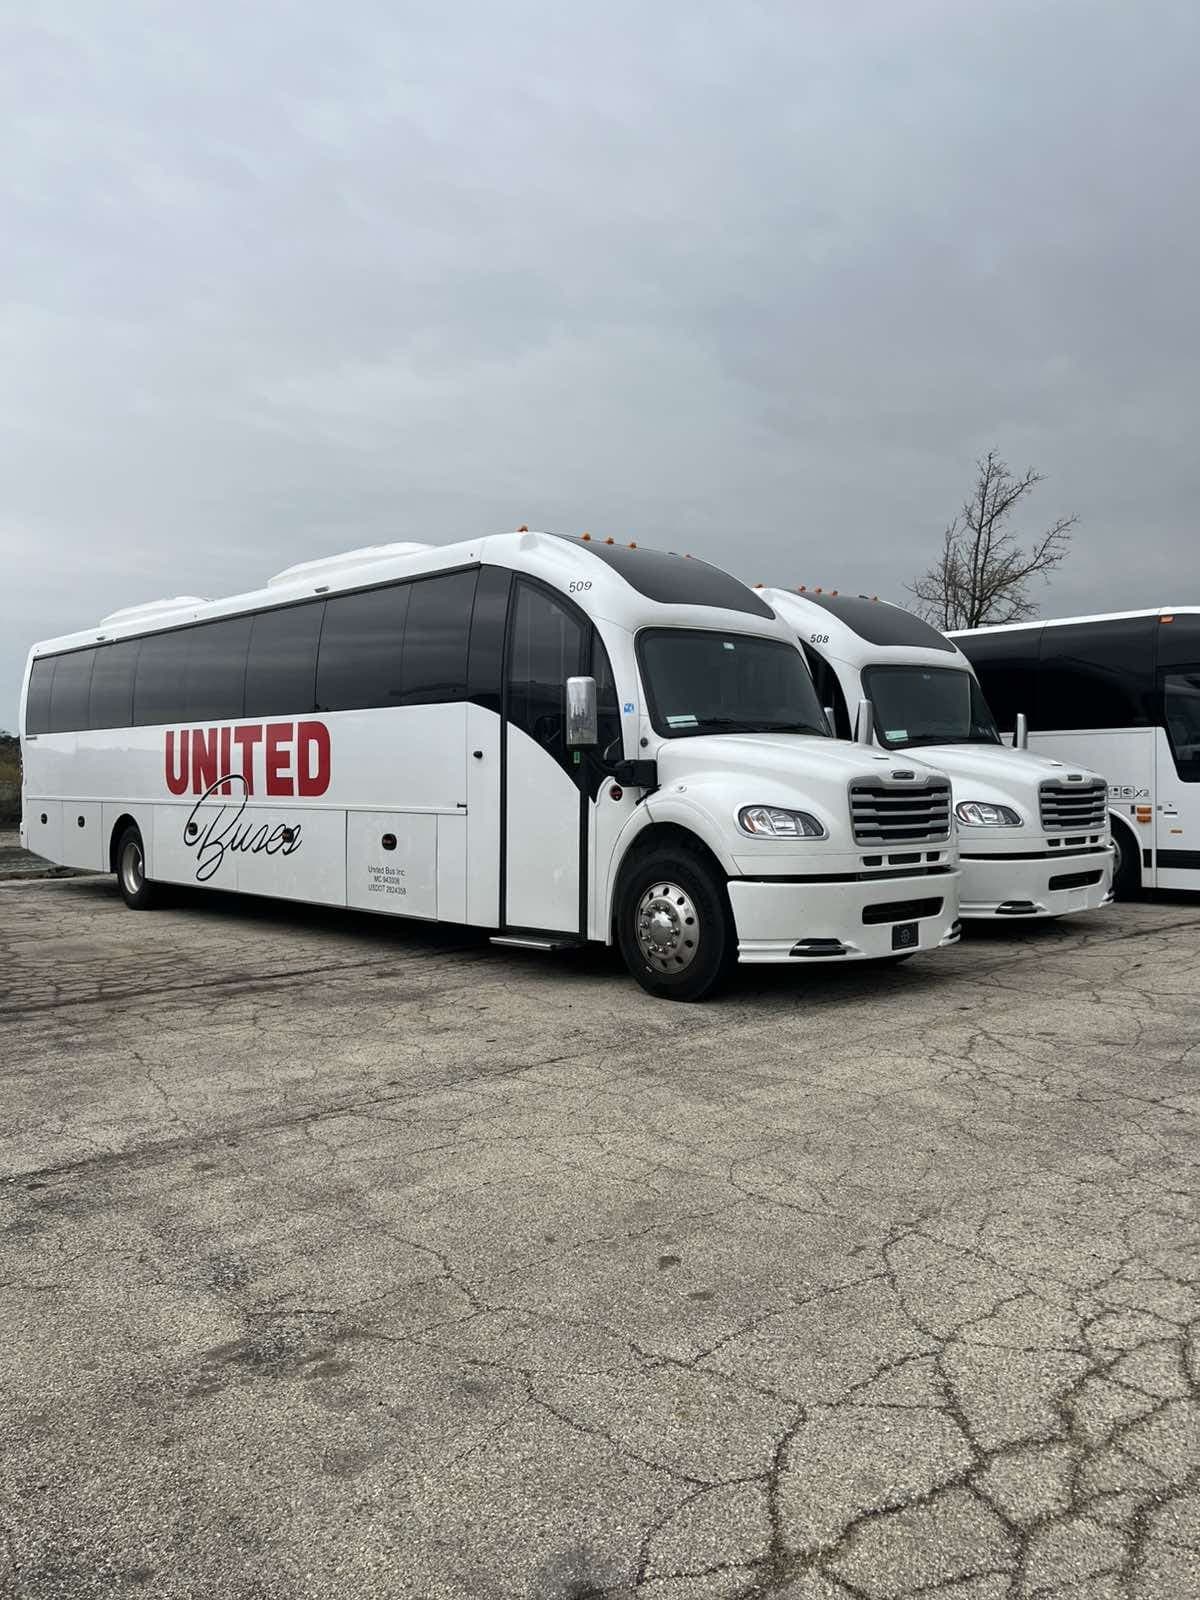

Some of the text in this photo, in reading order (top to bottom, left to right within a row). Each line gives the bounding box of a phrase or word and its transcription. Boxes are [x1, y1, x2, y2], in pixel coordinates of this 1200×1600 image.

[569, 581, 592, 593] 509
[810, 634, 829, 643] 508
[165, 721, 331, 797] UNITED
[184, 774, 302, 881] Buses
[368, 865, 384, 874] United
[385, 866, 396, 875] Bus
[368, 884, 386, 892] USDOT
